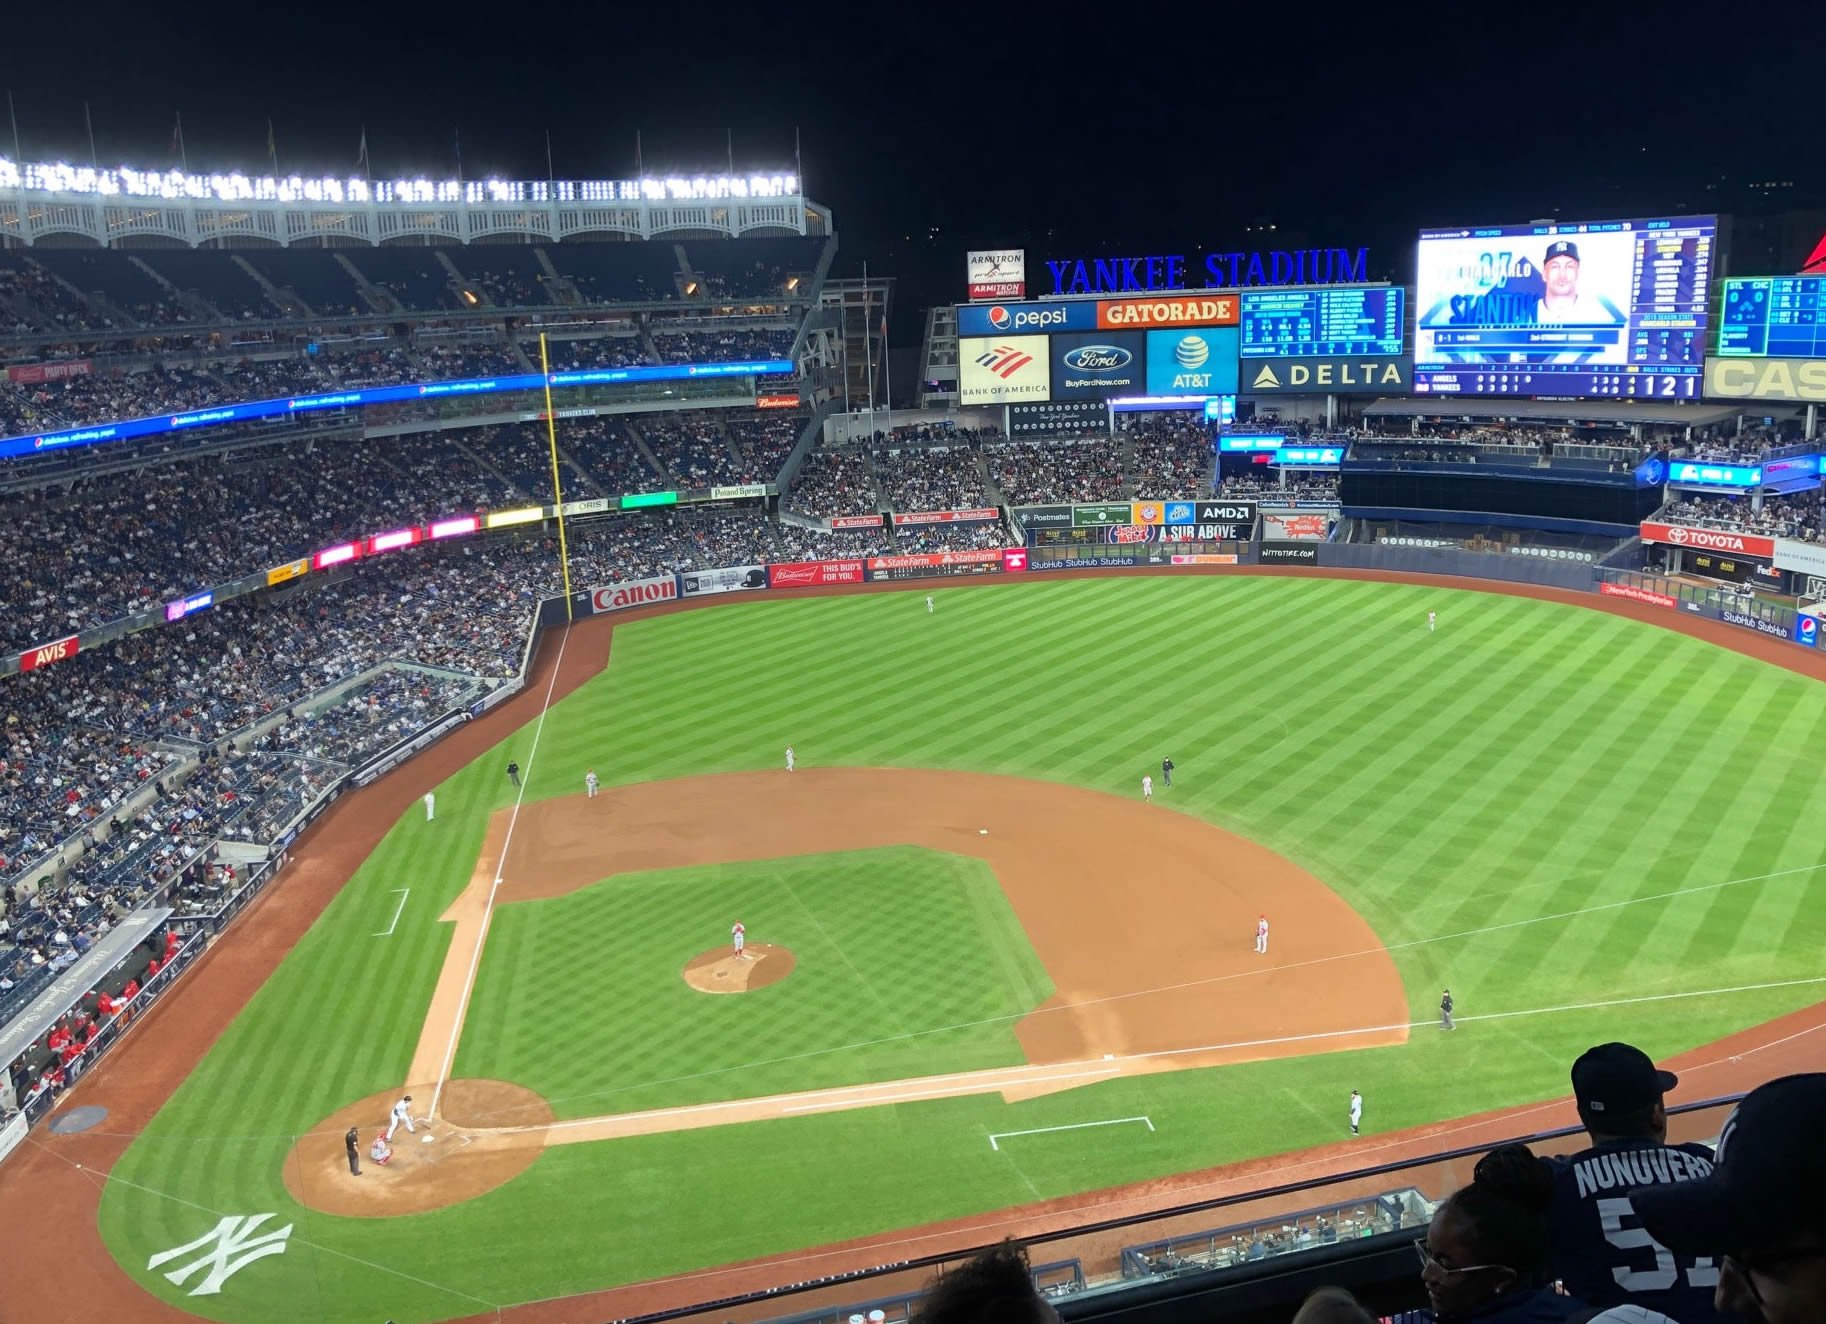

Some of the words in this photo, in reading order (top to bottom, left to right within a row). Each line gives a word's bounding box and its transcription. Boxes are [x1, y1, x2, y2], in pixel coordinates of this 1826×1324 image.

[971, 255, 1021, 264] ARMITRON
[1045, 256, 1185, 295] YANKEE
[1206, 247, 1369, 287] STADIUM
[974, 284, 1019, 293] ARMITRON
[1015, 307, 1067, 328] pepsi
[1106, 300, 1231, 324] GATORADE
[1077, 350, 1118, 367] Ford
[45, 366, 67, 378] PARTY
[69, 363, 88, 376] DECK
[1290, 363, 1401, 385] DELTA
[1065, 379, 1130, 388] BuyFordNow.com
[1173, 374, 1212, 388] AT&T
[1646, 376, 1655, 395] 1
[1662, 377, 1676, 395] 2
[1685, 377, 1695, 396] 1
[1005, 385, 1047, 393] AMERICA
[758, 397, 799, 409] Budweiser
[715, 486, 739, 497] Poland
[740, 485, 763, 496] Spring
[579, 501, 601, 510] ORIS
[1033, 513, 1070, 522] Postmates
[1203, 507, 1237, 519] AMD
[1159, 526, 1167, 541] A
[1170, 525, 1194, 540] SUB
[1198, 524, 1236, 540] ABOVE
[1688, 531, 1744, 550] TOYOTA
[822, 564, 838, 572] THIS
[840, 562, 861, 571] BUD'S
[1031, 560, 1063, 569] StubHub
[1066, 558, 1097, 567] StubHub
[1100, 557, 1133, 566] StubHub
[823, 573, 838, 581] FOR
[1757, 564, 1781, 577] FedEx
[594, 580, 676, 610] Canon
[1723, 611, 1756, 628] StubHub
[1757, 621, 1788, 638] StubHub
[35, 643, 67, 666] AVIS
